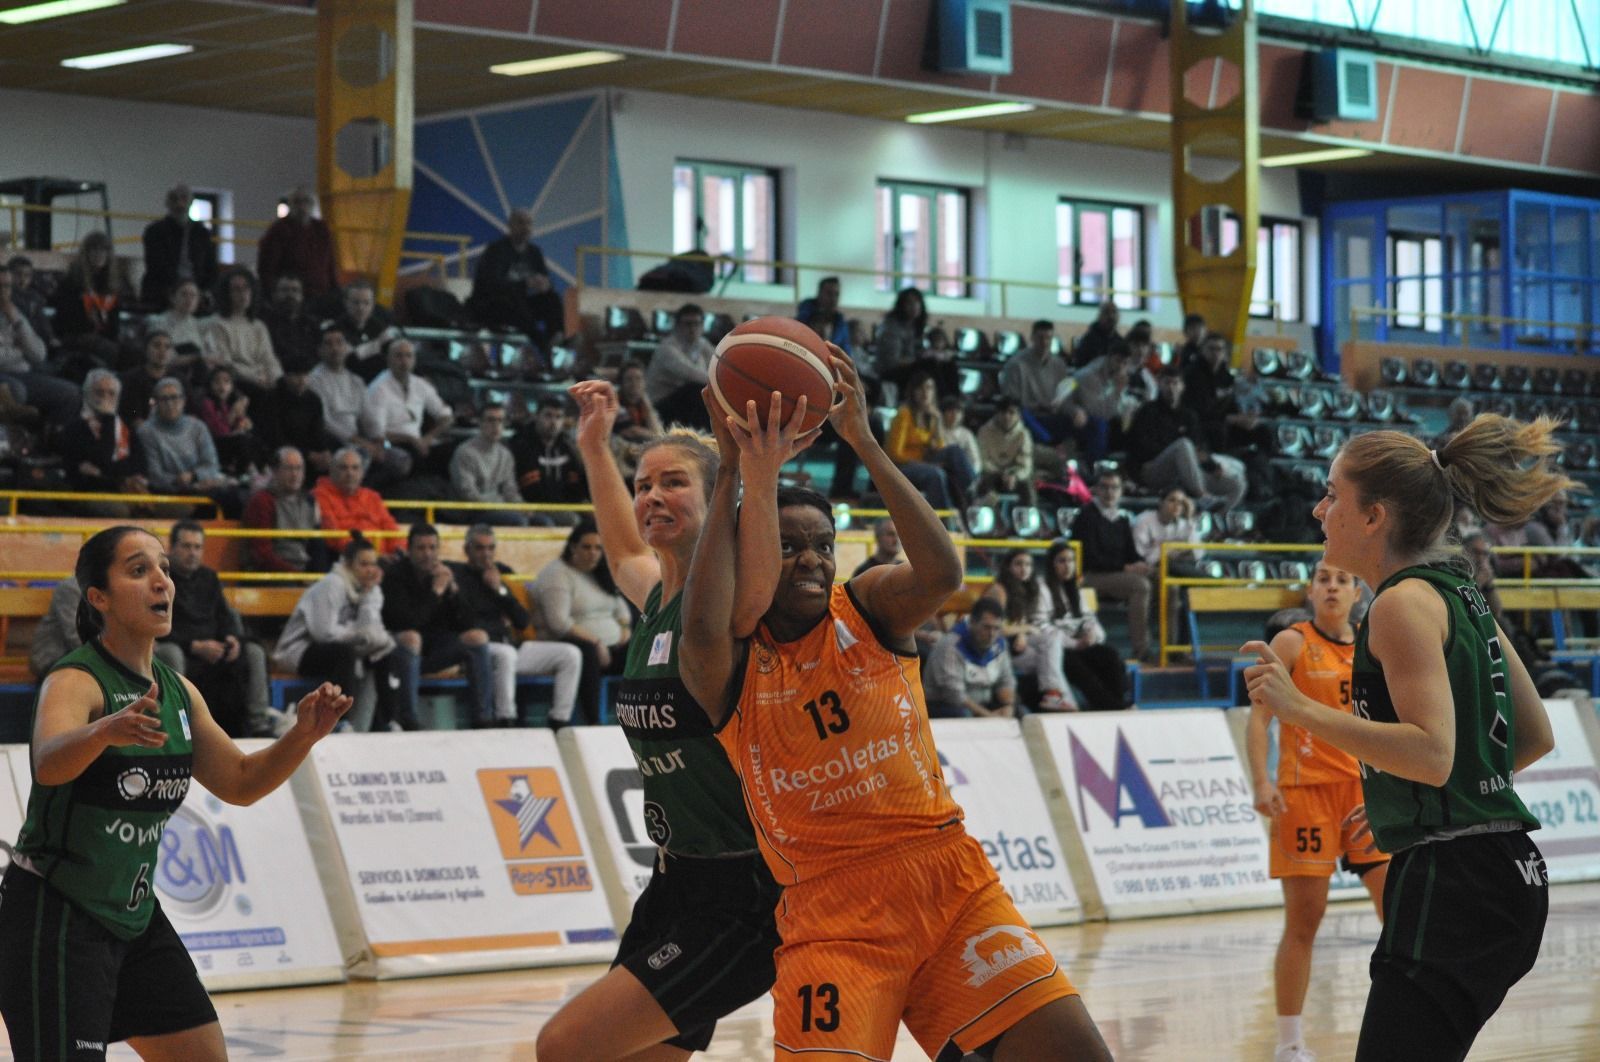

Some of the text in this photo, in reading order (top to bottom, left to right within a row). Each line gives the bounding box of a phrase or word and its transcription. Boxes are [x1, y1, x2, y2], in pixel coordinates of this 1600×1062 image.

[803, 690, 850, 741] 13
[389, 771, 402, 784] DE
[403, 771, 417, 784] LA
[418, 770, 447, 783] PLATA
[769, 734, 899, 794] Recoletas
[806, 771, 888, 812] Zamora
[1296, 828, 1322, 852] 55
[358, 869, 403, 885] SERVICIO
[404, 869, 413, 882] A
[413, 866, 464, 883] DOMICILIO
[511, 866, 590, 888] RepoSTAR
[797, 982, 840, 1033] 13
